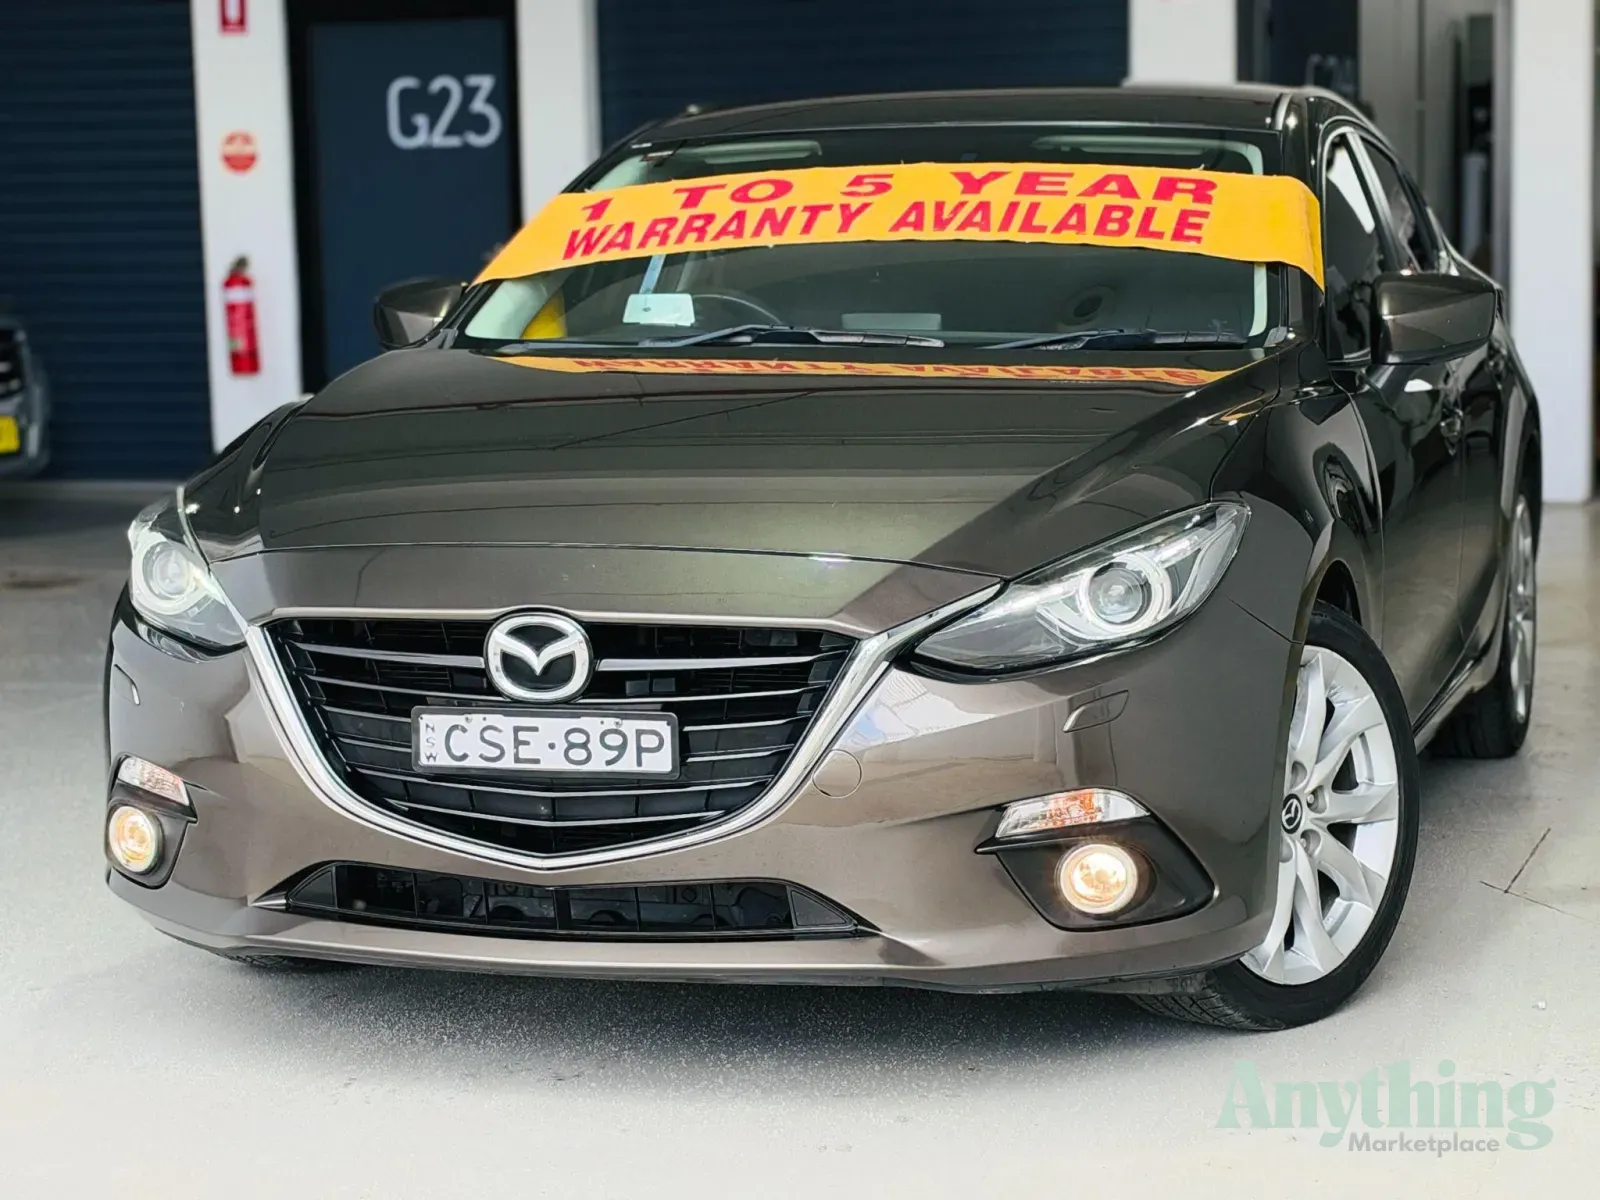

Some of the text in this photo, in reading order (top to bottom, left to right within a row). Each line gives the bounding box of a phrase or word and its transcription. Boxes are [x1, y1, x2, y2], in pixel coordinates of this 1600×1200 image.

[387, 75, 502, 149] G23
[581, 171, 1218, 222] 1 TO 5 YEAR
[563, 200, 1211, 260] WARRANTY AVAILABLE
